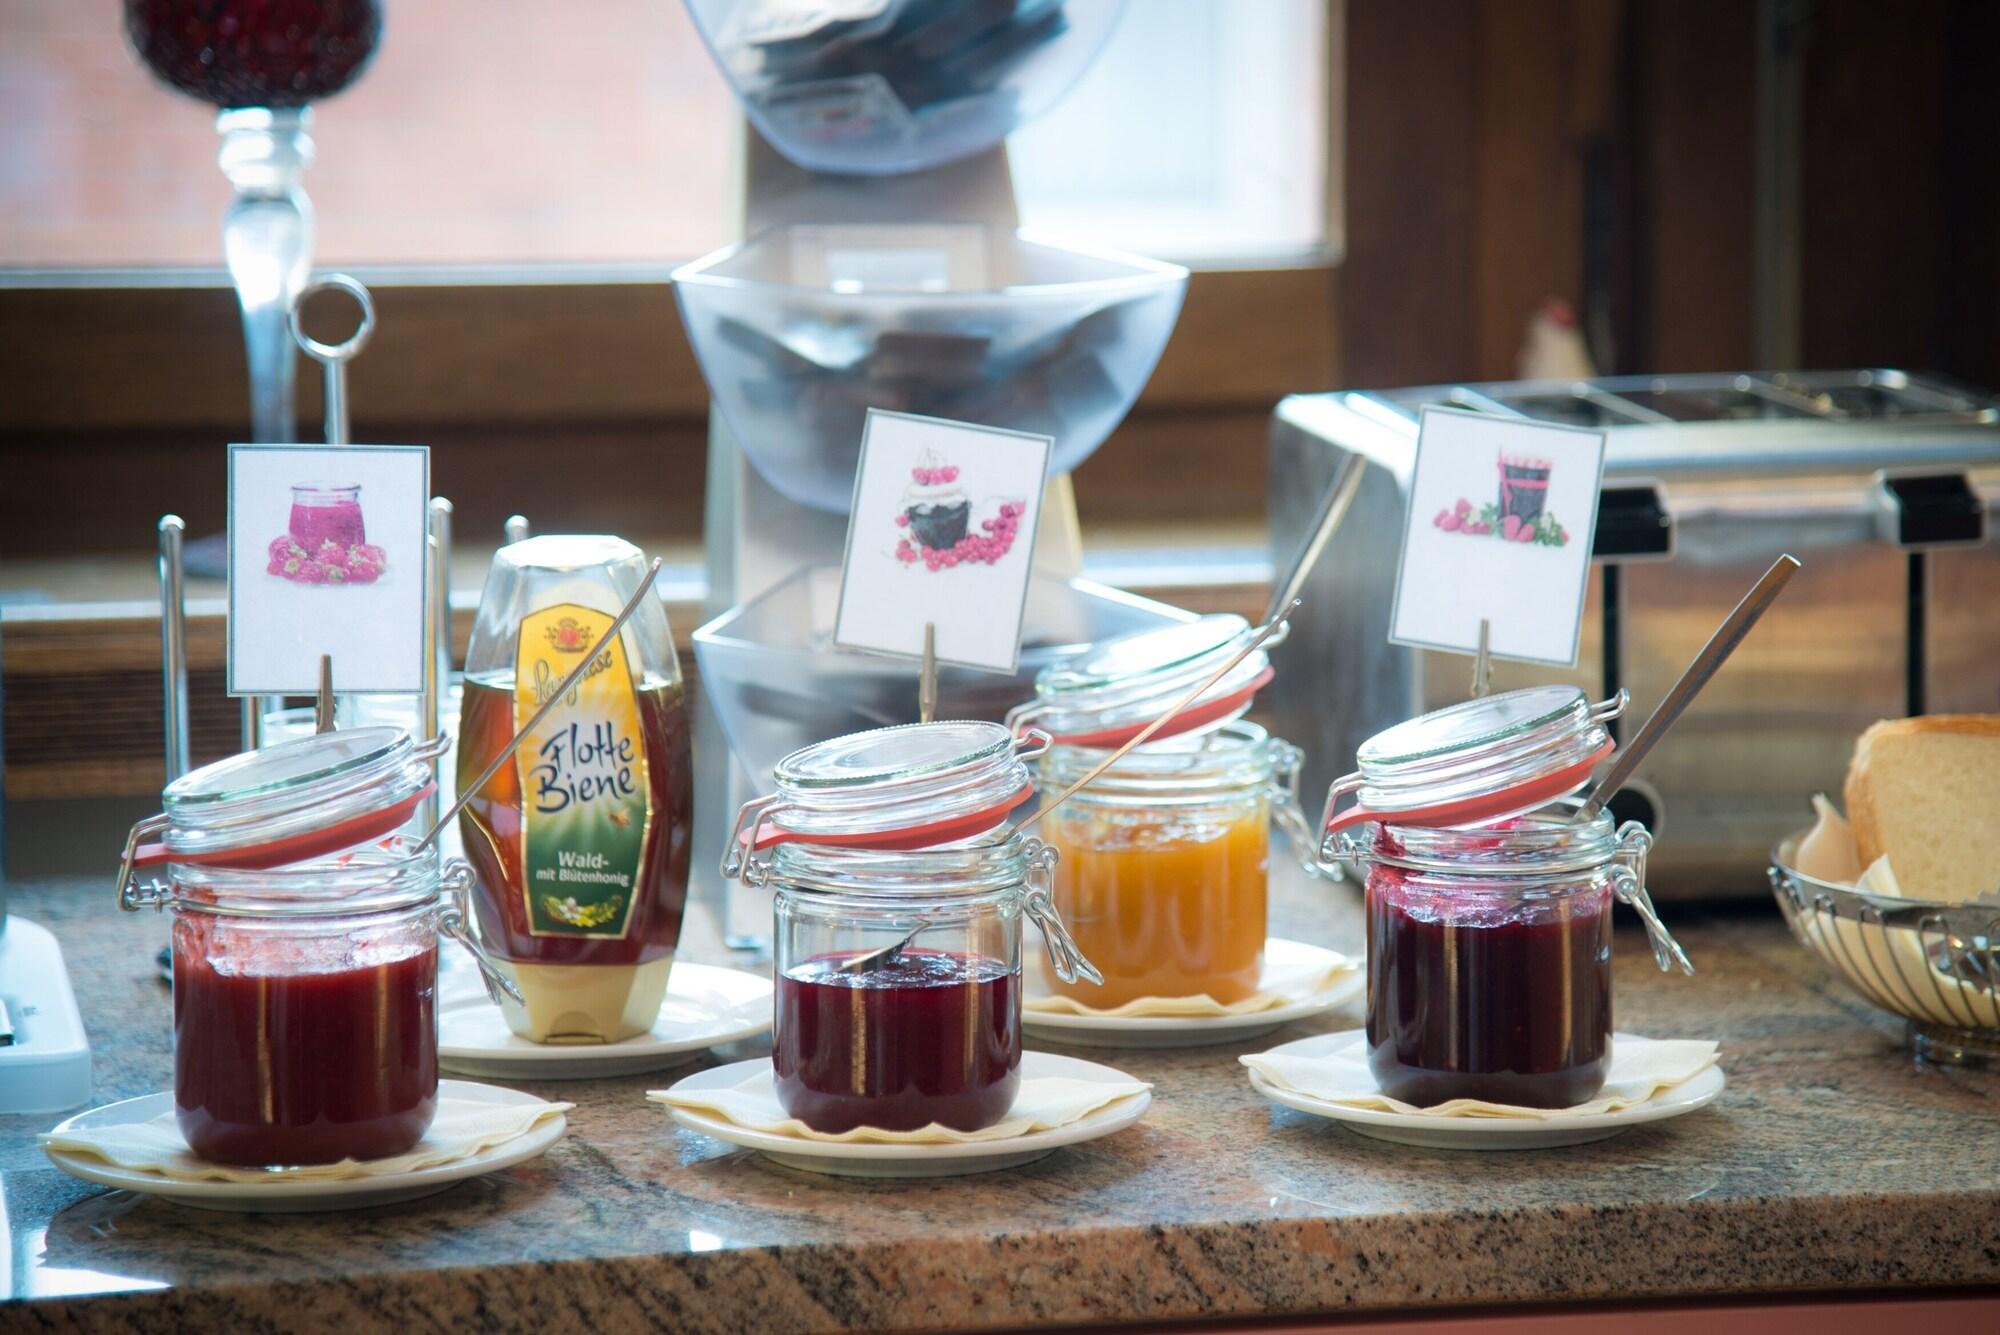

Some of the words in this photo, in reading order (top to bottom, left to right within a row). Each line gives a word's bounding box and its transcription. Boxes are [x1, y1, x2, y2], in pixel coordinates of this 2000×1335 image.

[540, 721, 634, 773] Flotte
[529, 765, 635, 814] Biene
[558, 850, 609, 869] Wald-
[536, 867, 556, 881] mit
[558, 868, 629, 888] Blütenhonig
